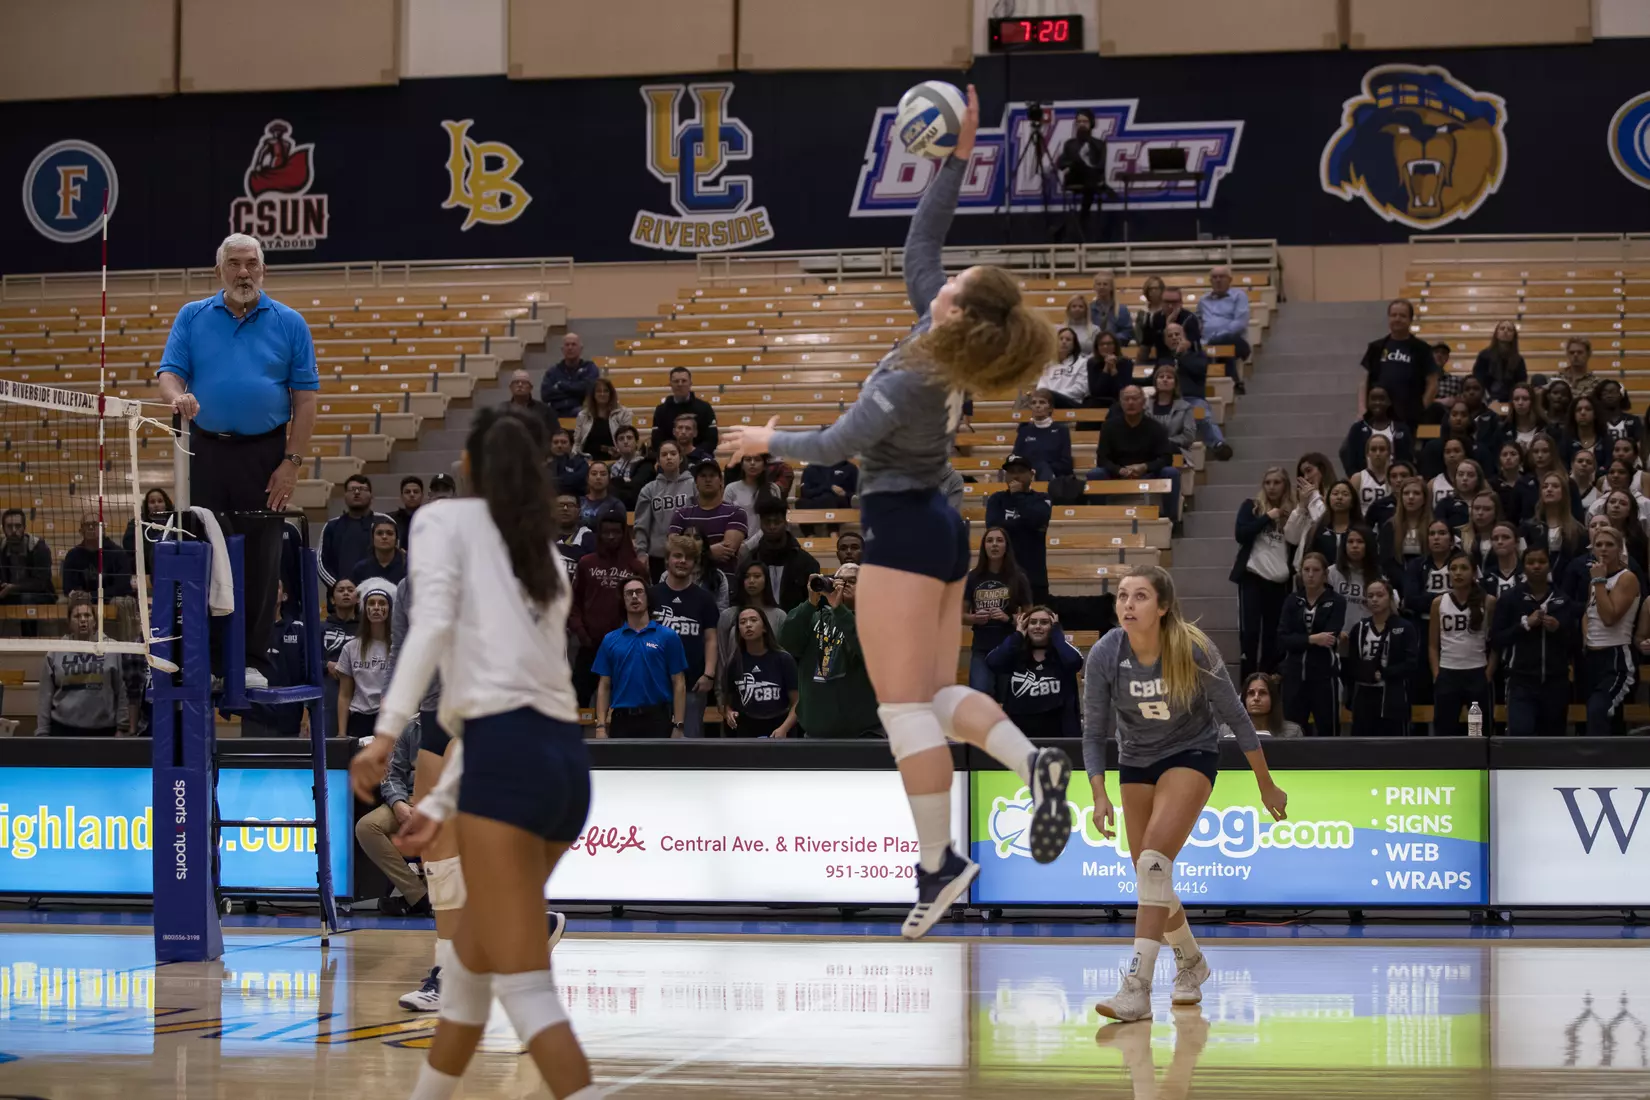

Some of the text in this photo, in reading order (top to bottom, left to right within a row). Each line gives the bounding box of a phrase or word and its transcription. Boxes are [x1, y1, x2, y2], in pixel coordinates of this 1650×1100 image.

[1019, 20, 1069, 42] 7:20
[56, 165, 88, 219] F
[232, 198, 325, 237] CSUN
[634, 211, 770, 248] RIVERSIDE
[260, 239, 315, 250] ATADORS
[12, 383, 50, 404] RIVERSIDE
[652, 494, 686, 511] CBU
[670, 622, 700, 636] CBU
[1442, 614, 1468, 632] CB
[754, 687, 781, 702] CBU
[1029, 680, 1061, 697] CBU
[1129, 678, 1169, 698] CBU
[173, 780, 187, 824] sports
[1386, 787, 1456, 805] PRINT
[1385, 815, 1453, 834] SIGNS
[1553, 787, 1650, 855] W
[660, 836, 727, 852] Central
[732, 836, 769, 852] Ave.
[775, 836, 789, 852] &
[794, 836, 878, 853] Riverside
[884, 836, 919, 853] Plaz
[1385, 843, 1439, 862] WEB
[826, 865, 919, 879] 951-300-20
[1082, 861, 1127, 877] Mark
[1176, 861, 1252, 881] Territory
[1385, 871, 1472, 890] WRAPS
